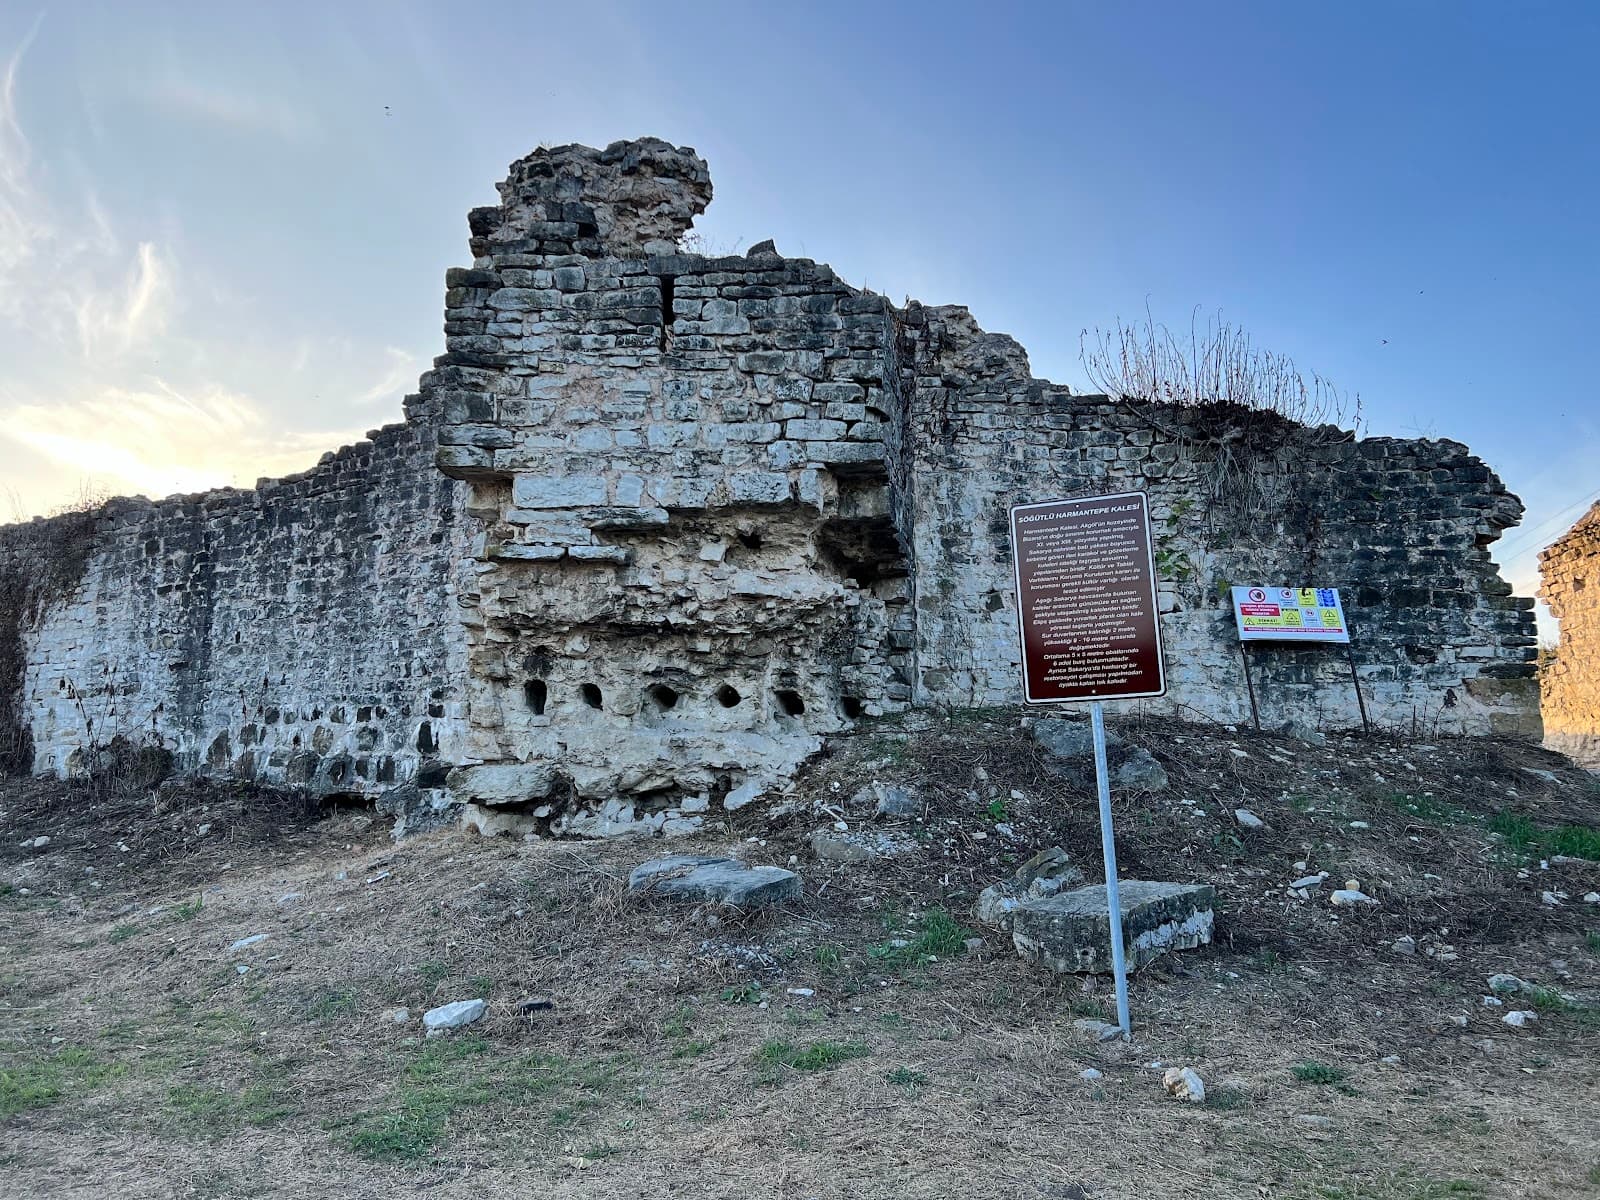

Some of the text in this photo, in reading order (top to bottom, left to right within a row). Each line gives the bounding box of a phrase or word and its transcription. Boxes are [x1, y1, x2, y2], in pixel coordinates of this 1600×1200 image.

[1018, 502, 1140, 523] SÖĞÜTLÜ HARMANTEPE KALESİ
